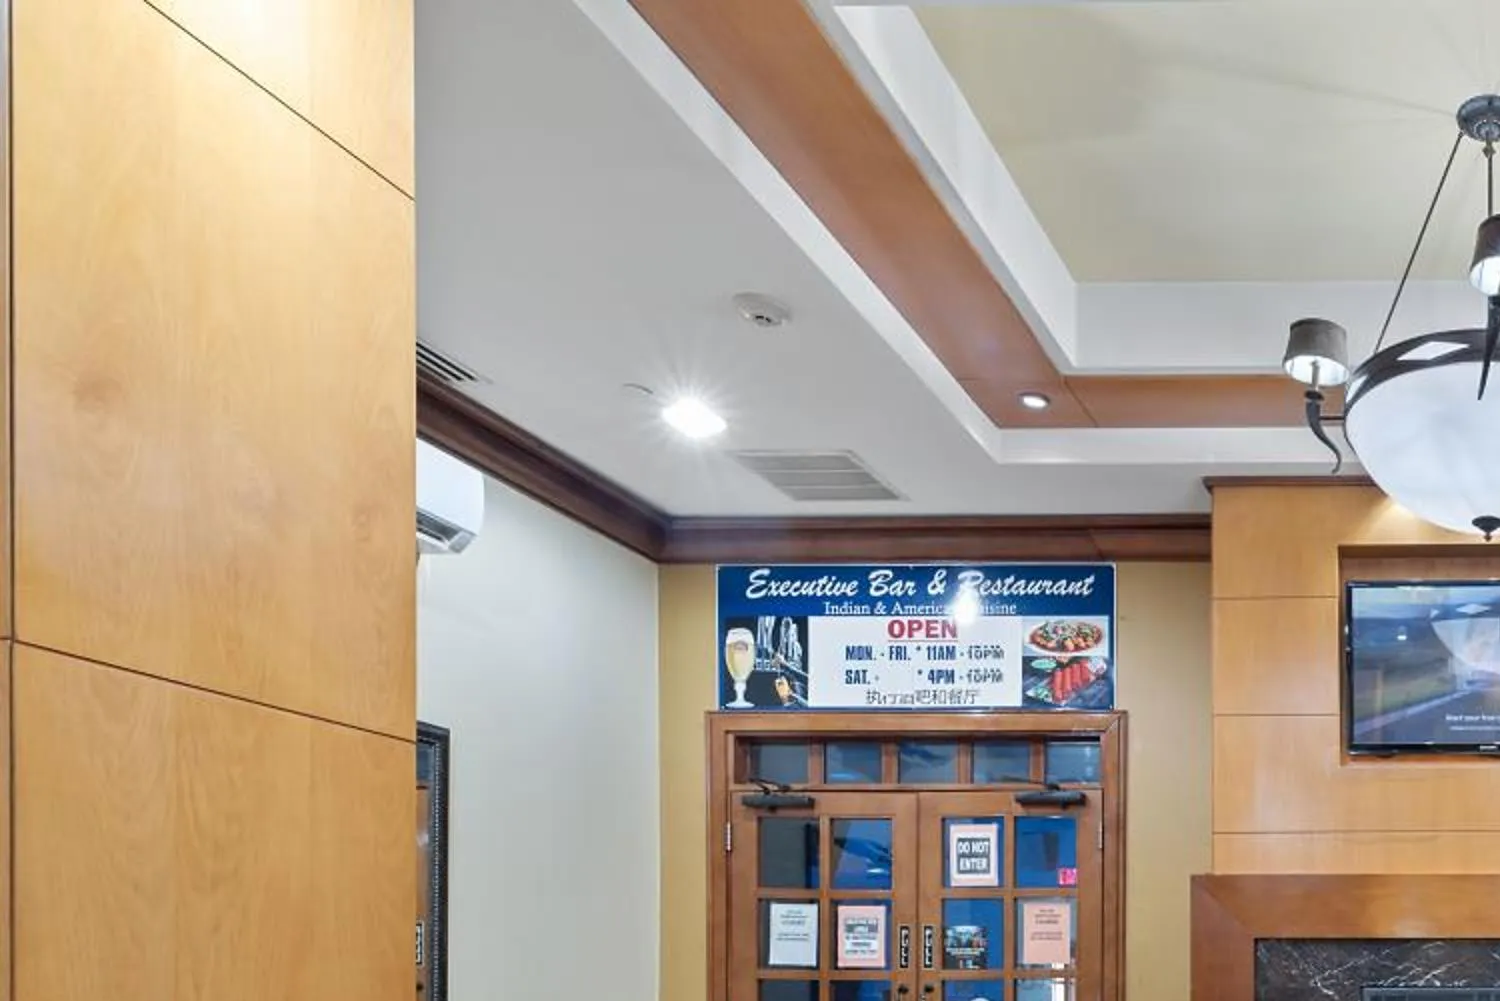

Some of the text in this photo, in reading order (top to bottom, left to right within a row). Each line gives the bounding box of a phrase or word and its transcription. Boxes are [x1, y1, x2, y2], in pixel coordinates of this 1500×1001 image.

[745, 568, 1096, 599] Executive Bar & Restaurant
[824, 601, 871, 615] Indian
[874, 602, 886, 615] &
[891, 601, 961, 615] America
[887, 619, 958, 639] OPEN
[845, 645, 876, 661] MON.
[889, 645, 912, 661] FRI.
[926, 645, 957, 661] 11AM
[845, 669, 871, 685] SAT.
[927, 669, 955, 685] 4PM
[971, 841, 989, 854] NOT
